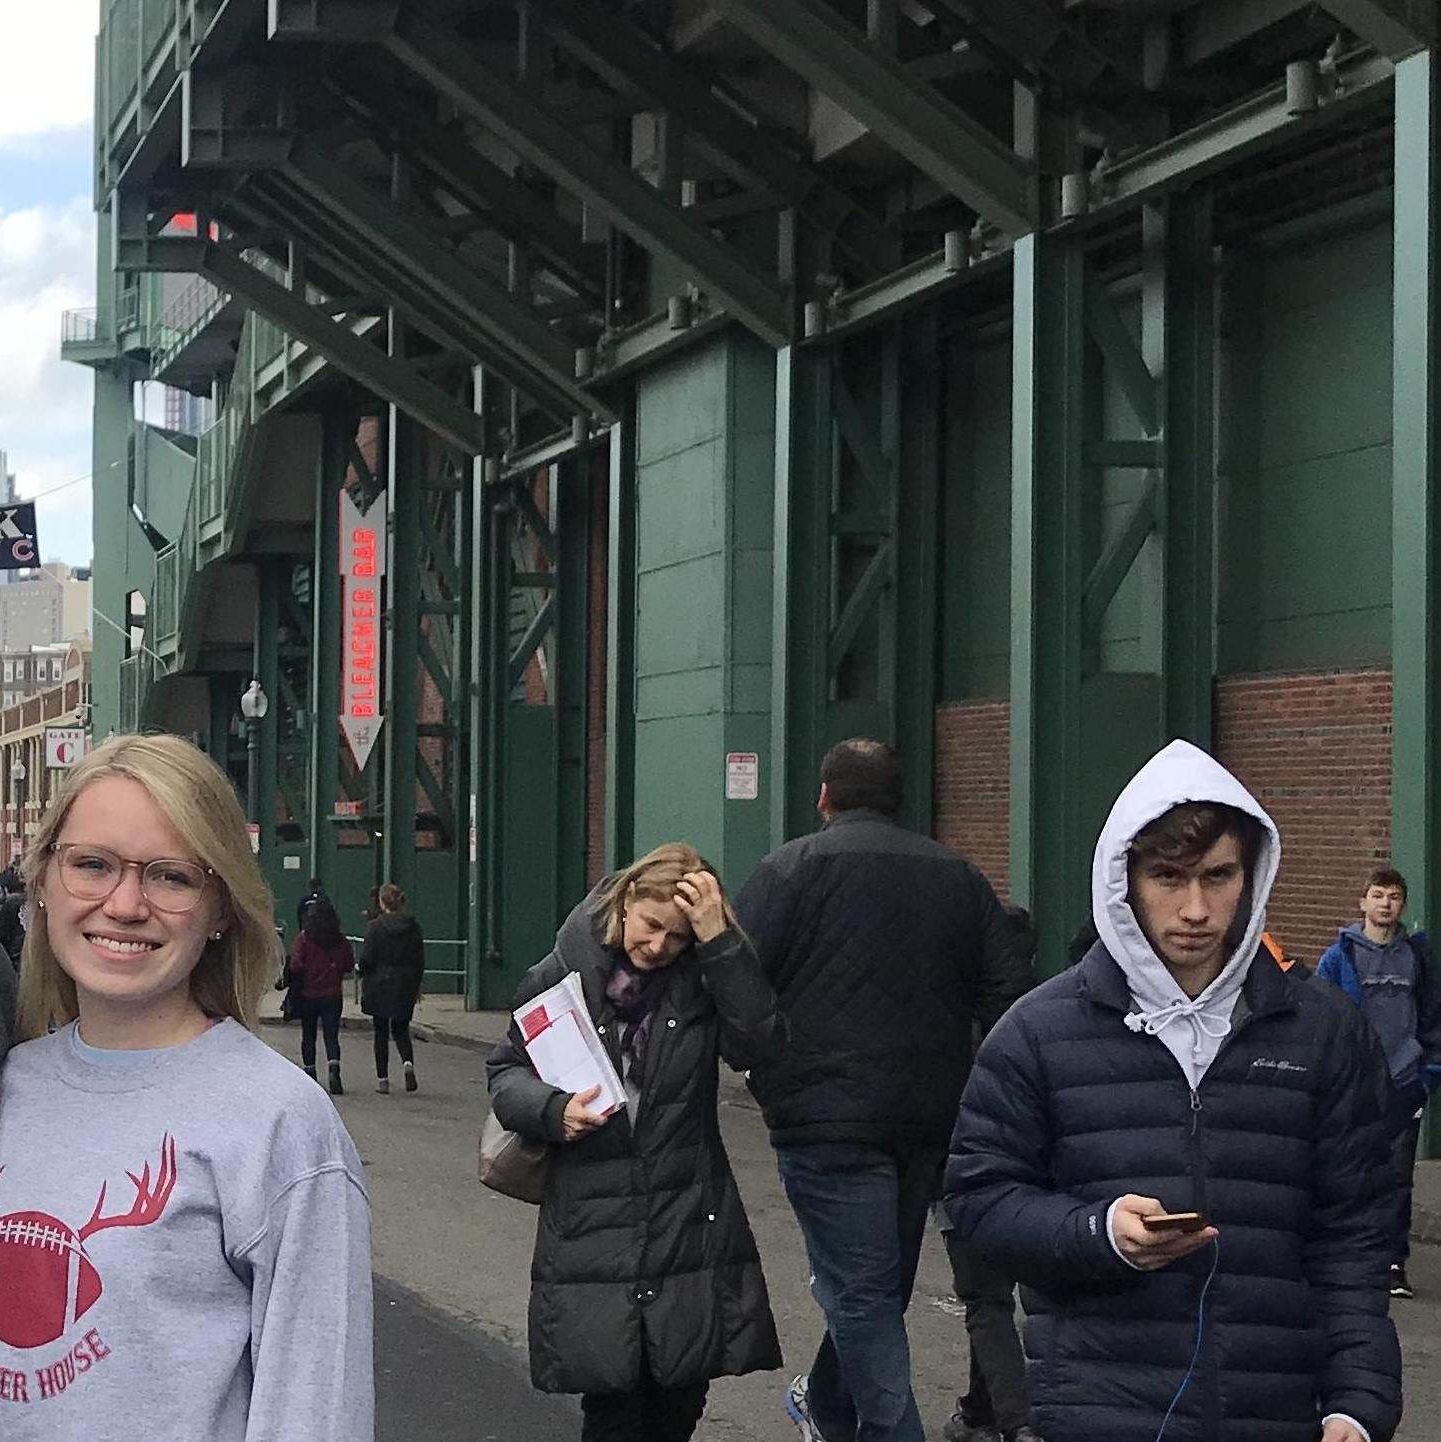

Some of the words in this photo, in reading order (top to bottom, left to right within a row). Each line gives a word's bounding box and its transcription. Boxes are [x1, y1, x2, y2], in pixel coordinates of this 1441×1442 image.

[12, 540, 34, 562] C
[352, 527, 375, 577] BAR
[351, 589, 375, 717] BLEACHER
[49, 731, 80, 739] GATE
[57, 742, 74, 764] C
[35, 1327, 112, 1401] HOUSE
